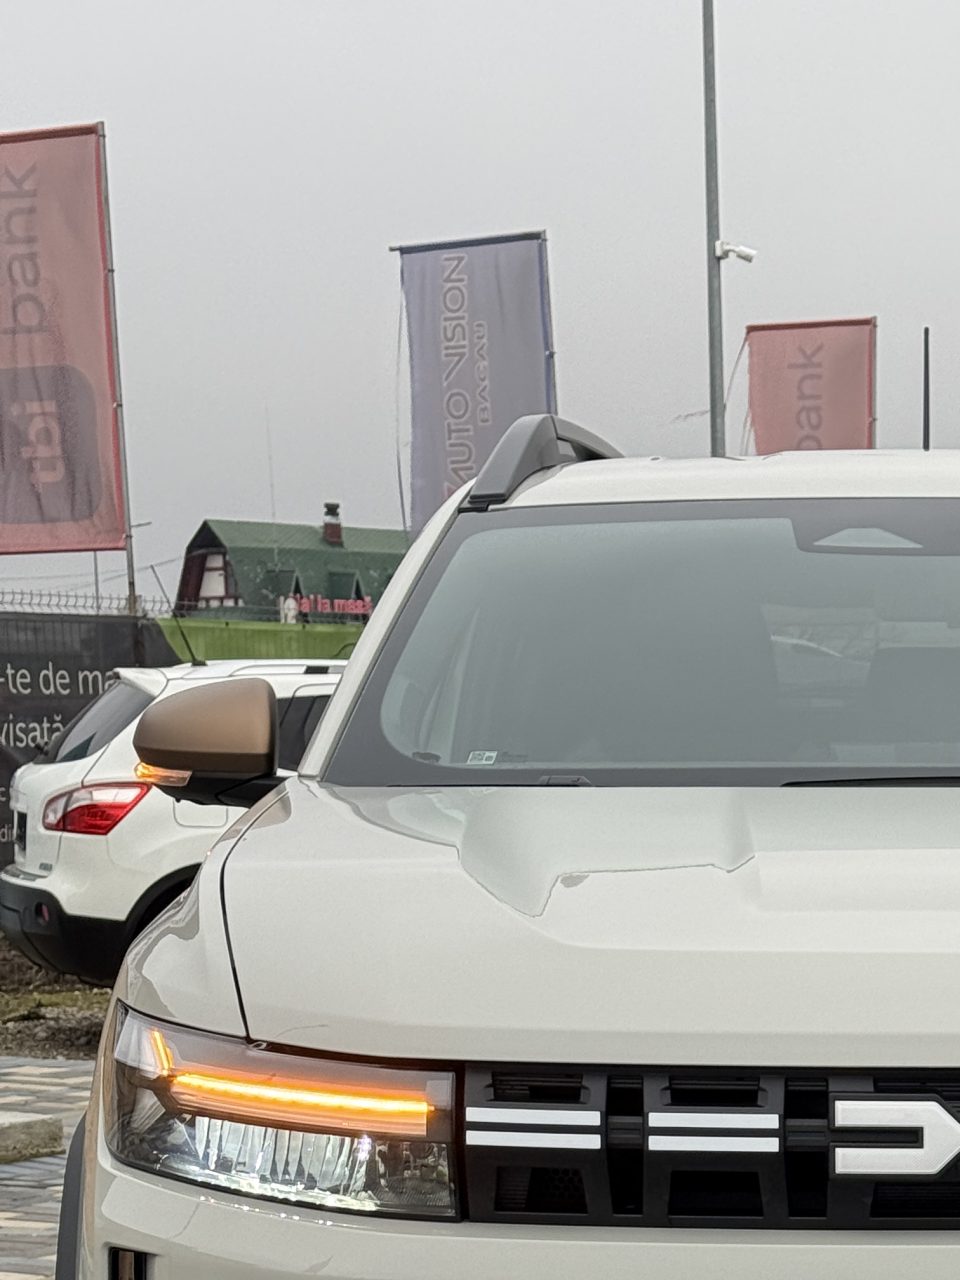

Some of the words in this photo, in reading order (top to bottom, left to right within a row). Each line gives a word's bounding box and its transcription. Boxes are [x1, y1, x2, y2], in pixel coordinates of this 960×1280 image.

[442, 254, 469, 385] VISION
[474, 321, 490, 425] BACAU
[39, 661, 71, 694] de
